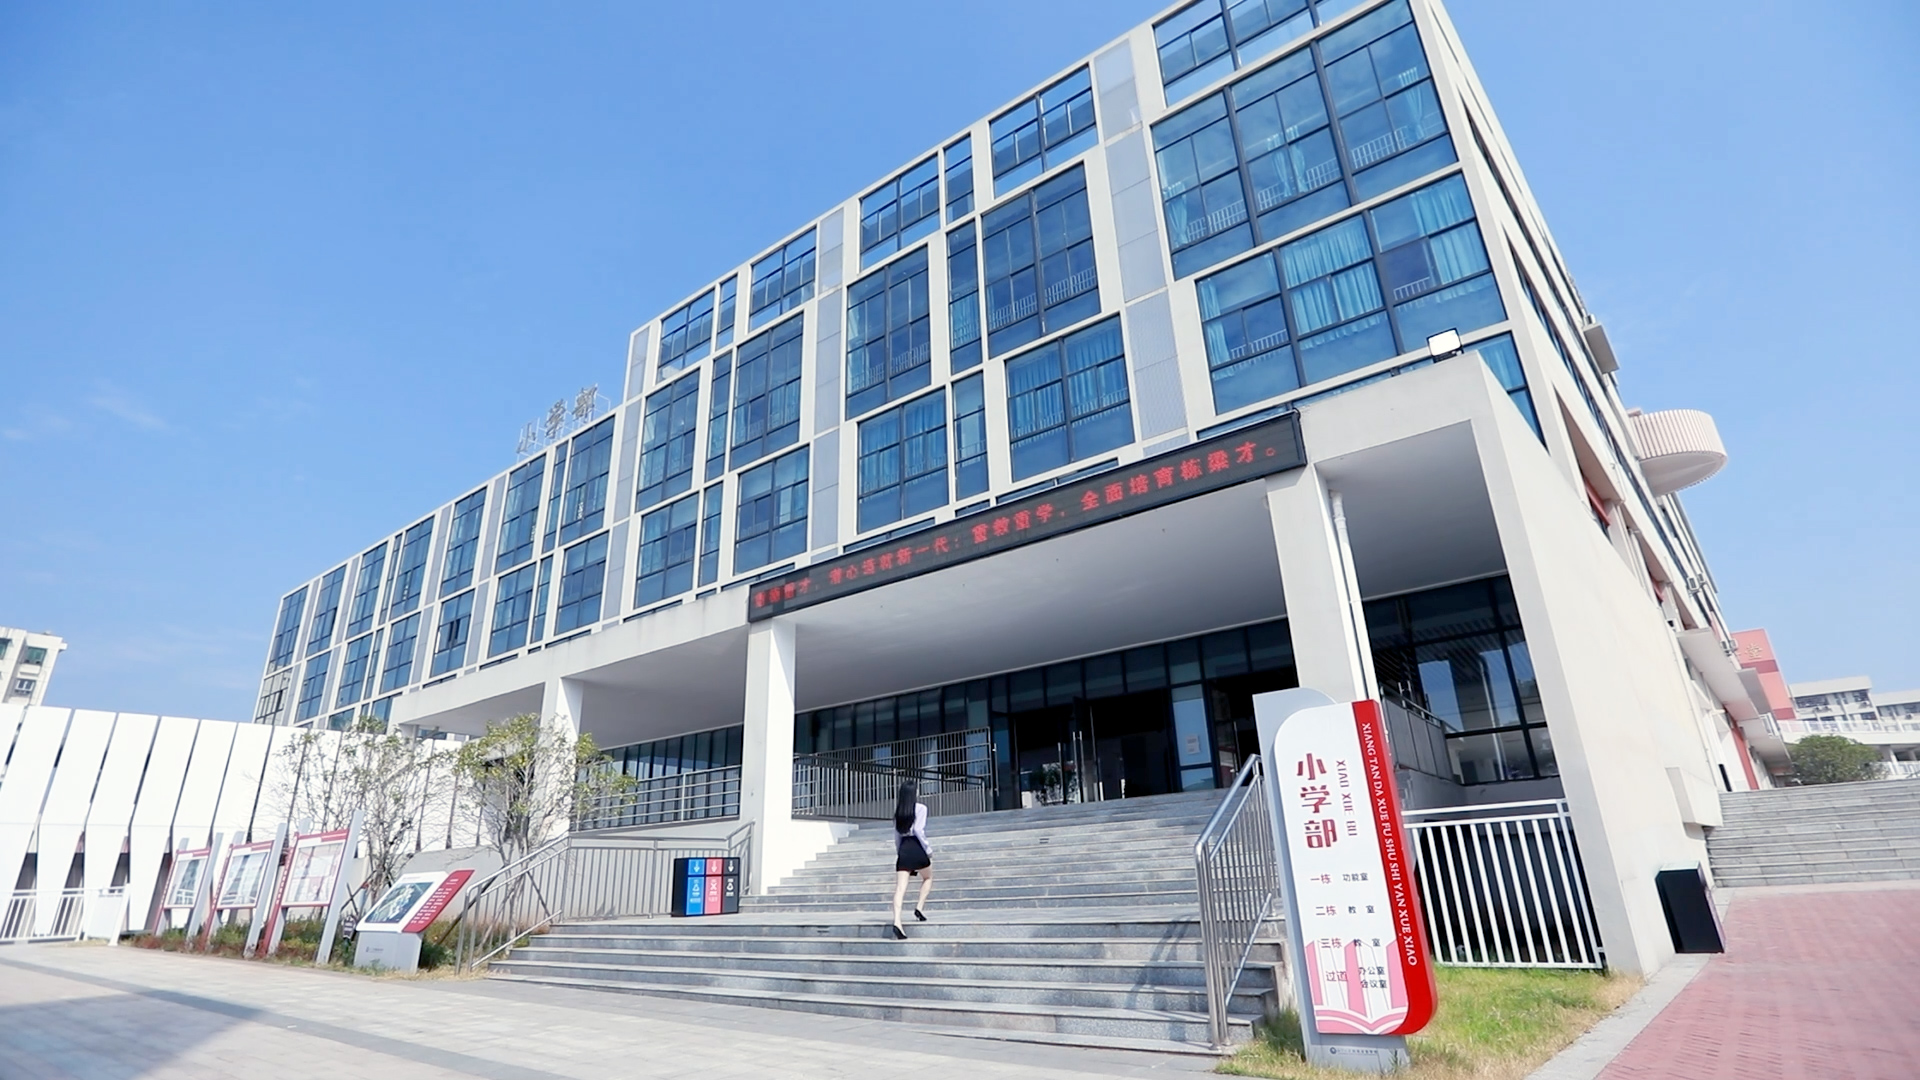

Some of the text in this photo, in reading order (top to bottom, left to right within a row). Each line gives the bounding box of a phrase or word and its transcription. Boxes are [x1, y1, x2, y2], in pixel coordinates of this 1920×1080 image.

[1297, 752, 1338, 849] 小学部
[1362, 722, 1418, 967] XIANG TAN DA XUE FU SHU SHI YAN XUE XIAO
[1310, 872, 1369, 884] 一栋 功能室
[1315, 905, 1337, 916] 二栋
[1320, 938, 1342, 949] 三栋
[1358, 966, 1385, 976] 办公室
[1360, 979, 1387, 989] 会议室
